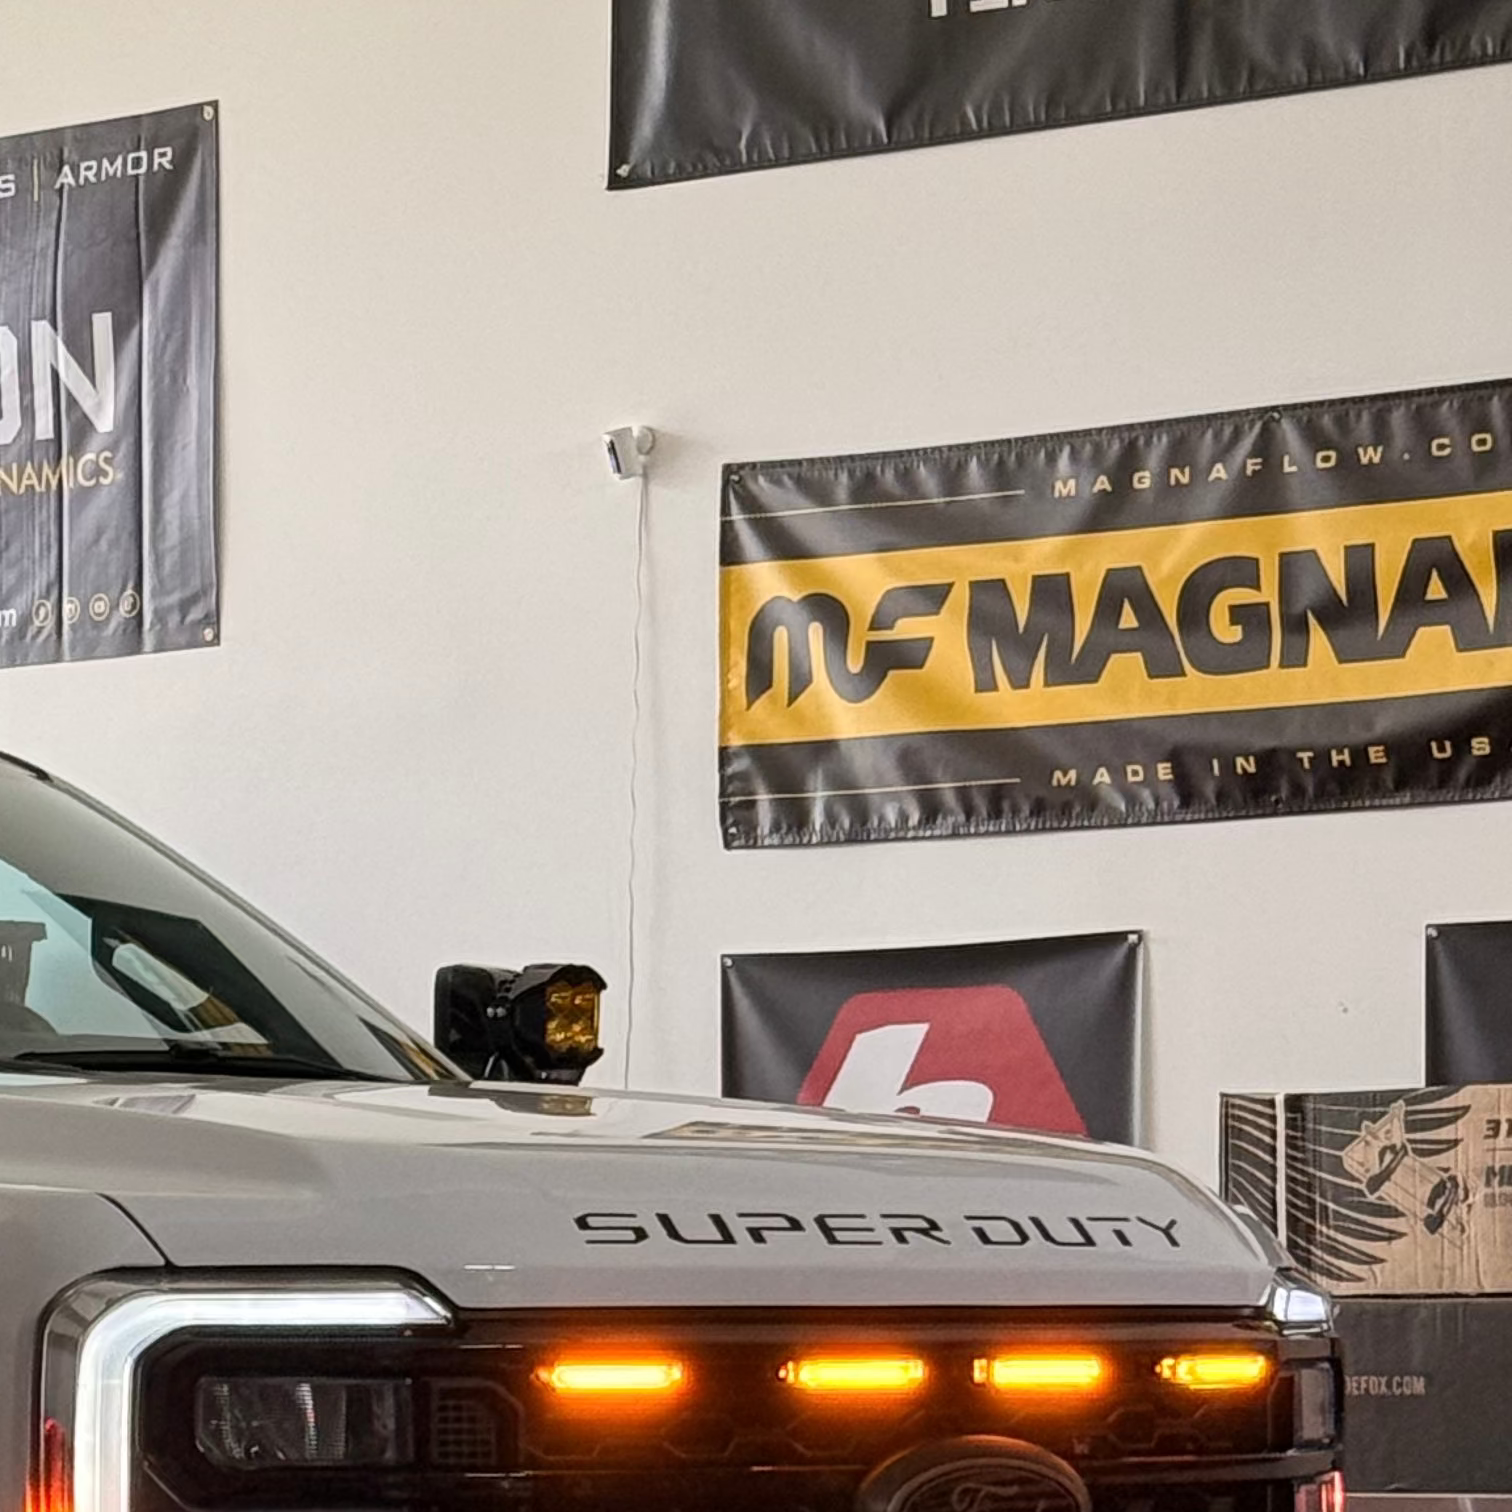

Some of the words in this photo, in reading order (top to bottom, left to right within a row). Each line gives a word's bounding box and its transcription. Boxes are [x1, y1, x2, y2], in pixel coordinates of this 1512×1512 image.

[54, 147, 175, 189] ARMOR
[967, 528, 1512, 694] MAGNA
[1051, 761, 1175, 788] MADE
[1212, 754, 1257, 776] IN
[1296, 744, 1388, 771] THE
[1429, 736, 1512, 760] US
[573, 1212, 951, 1246] SUPER
[964, 1215, 1181, 1248] DUTY
